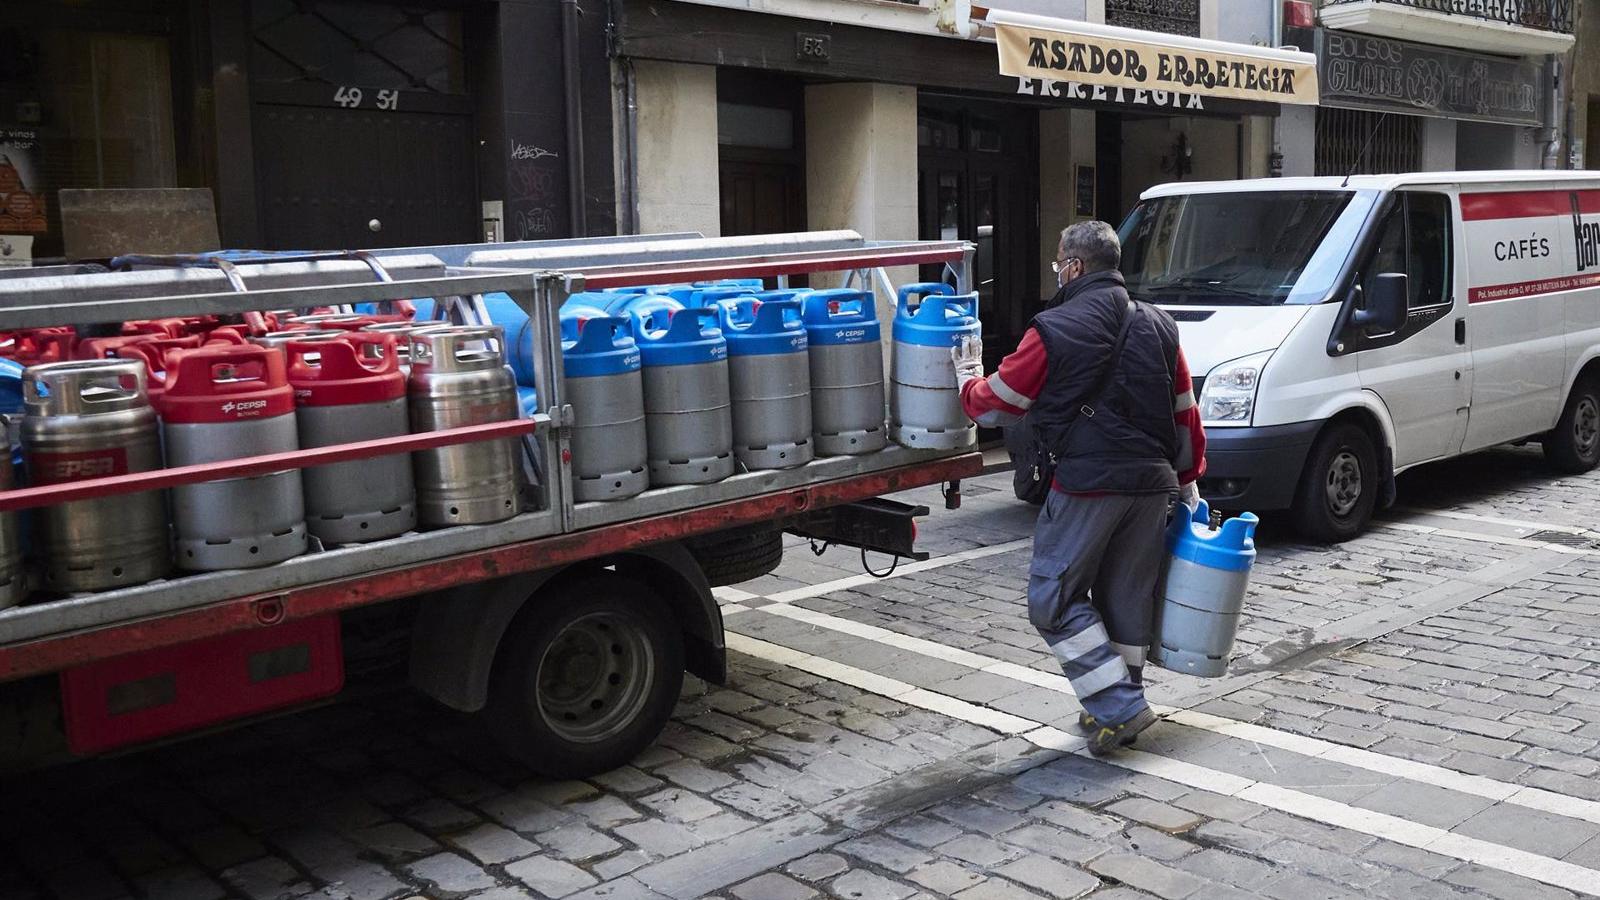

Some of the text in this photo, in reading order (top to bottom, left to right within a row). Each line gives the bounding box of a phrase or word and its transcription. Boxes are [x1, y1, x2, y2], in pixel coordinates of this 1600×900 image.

[1027, 37, 1148, 82] ASADOR
[1329, 36, 1402, 62] BOLSOS
[1328, 59, 1403, 98] GLOBE
[333, 86, 399, 110] 49 51
[8, 128, 36, 138] vinos
[1494, 232, 1550, 261] CAFÉS
[236, 400, 267, 410] CEPSA
